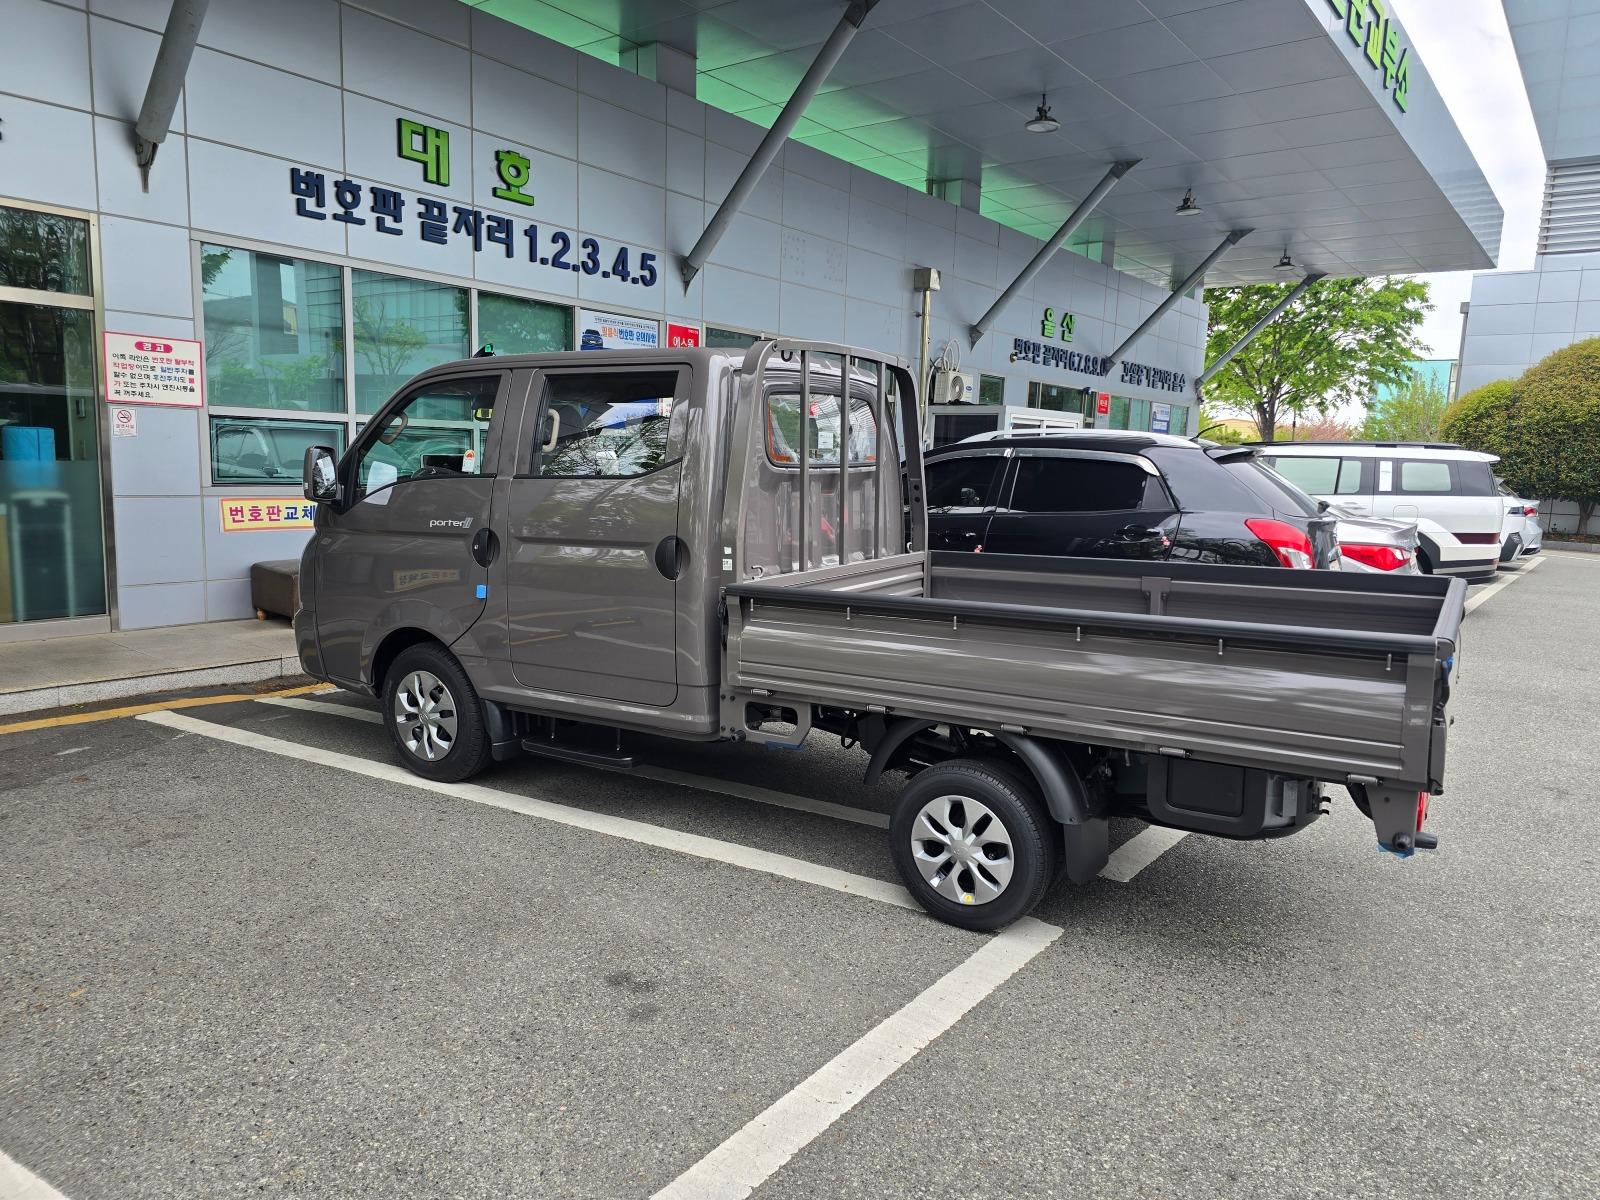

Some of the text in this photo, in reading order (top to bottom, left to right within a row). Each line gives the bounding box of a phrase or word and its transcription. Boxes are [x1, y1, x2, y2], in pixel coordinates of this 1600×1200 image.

[290, 167, 657, 287] 번호판 끝자리 1.2.3.4.5
[1042, 307, 1076, 342] 울산
[128, 354, 150, 363] 라인은
[1014, 338, 1041, 364] 번호판
[129, 372, 151, 381] 없으며
